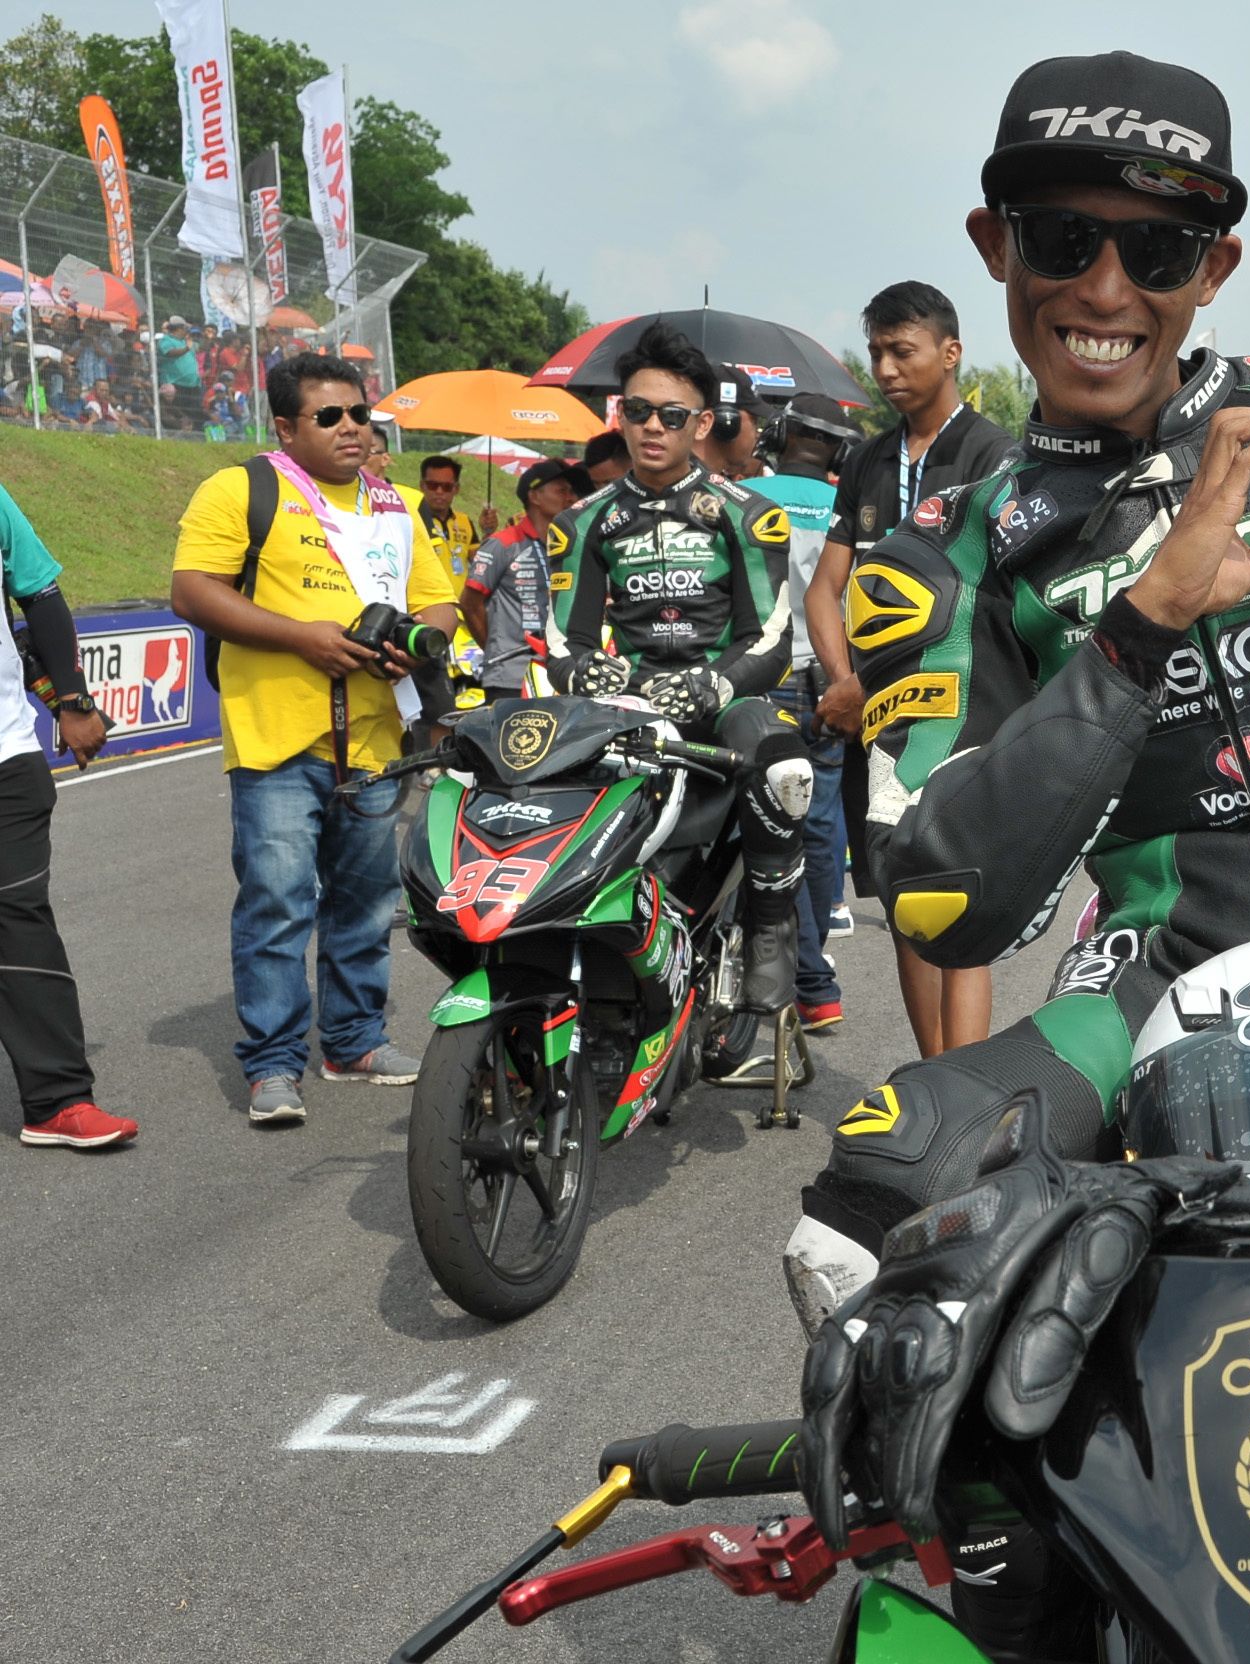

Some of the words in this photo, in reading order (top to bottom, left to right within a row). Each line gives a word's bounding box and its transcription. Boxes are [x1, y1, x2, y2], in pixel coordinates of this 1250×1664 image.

[1180, 356, 1229, 420] TAICHI
[1028, 432, 1101, 454] TAICHI
[671, 467, 702, 493] TAICHI
[335, 706, 345, 730] EOS
[437, 856, 550, 912] 93
[959, 1535, 1009, 1554] RT-RACE
